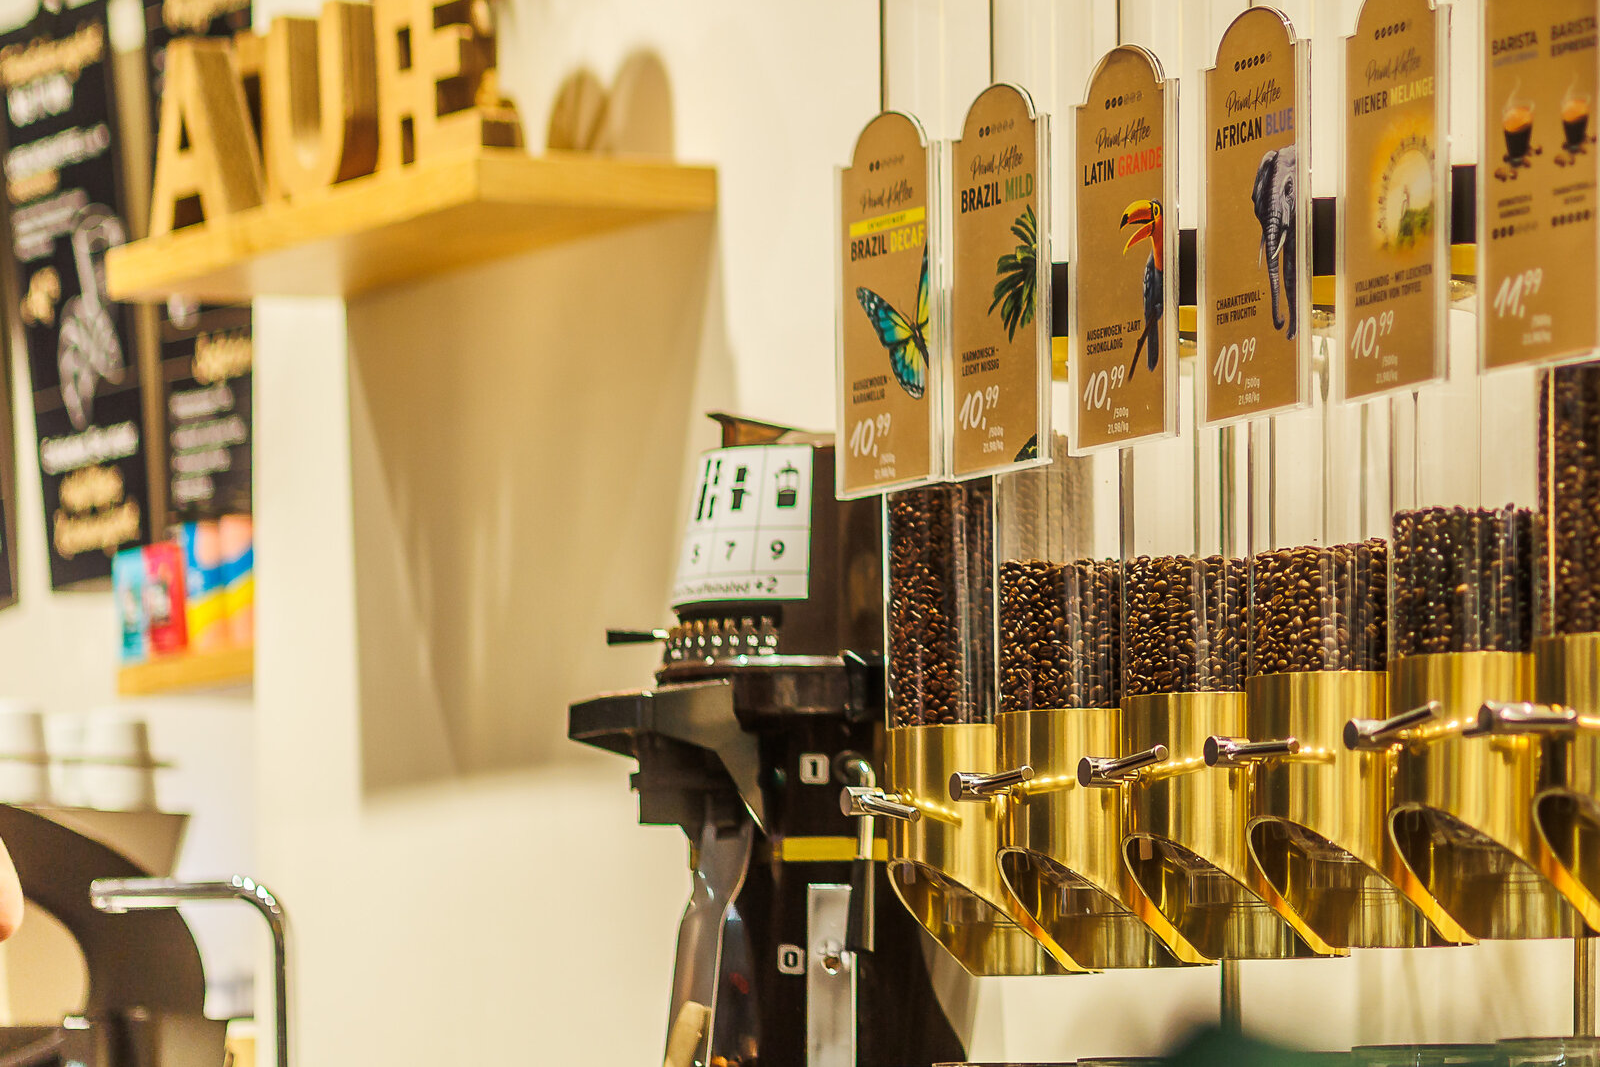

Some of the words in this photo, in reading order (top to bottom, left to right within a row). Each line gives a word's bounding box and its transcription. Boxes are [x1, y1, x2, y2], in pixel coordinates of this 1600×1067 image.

[1492, 31, 1538, 56] BARISTA
[1354, 91, 1388, 116] WIENER
[1390, 76, 1434, 106] MELANGE
[1215, 116, 1262, 151] AFRICAN
[1265, 107, 1294, 137] BLUE
[1084, 157, 1115, 186] LATIN
[1118, 145, 1163, 178] GRANDE
[961, 181, 1002, 214] BRAZIL
[1005, 172, 1034, 203] MILD
[851, 234, 888, 263] BRAZIL
[890, 224, 925, 253] DECAF
[1216, 289, 1261, 311] CHARAKTERVOLL
[1216, 312, 1229, 325] FEIN
[1230, 305, 1257, 323] FRUCHTIG
[1087, 323, 1122, 342] AUSGEWOGEN
[1127, 319, 1141, 333] ZART
[1087, 338, 1123, 355] SCHOKOLADIG
[1351, 309, 1394, 360] 10,99
[962, 346, 996, 363] HARMONISCH
[962, 364, 980, 377] LEICHT
[1213, 336, 1257, 386] 10,99
[1083, 364, 1125, 412] 10,99
[959, 384, 999, 431] 10,99
[849, 412, 891, 458] 10,99
[724, 540, 737, 561] 7
[770, 540, 785, 560] 9
[810, 759, 818, 777] 1
[784, 951, 798, 968] 0
